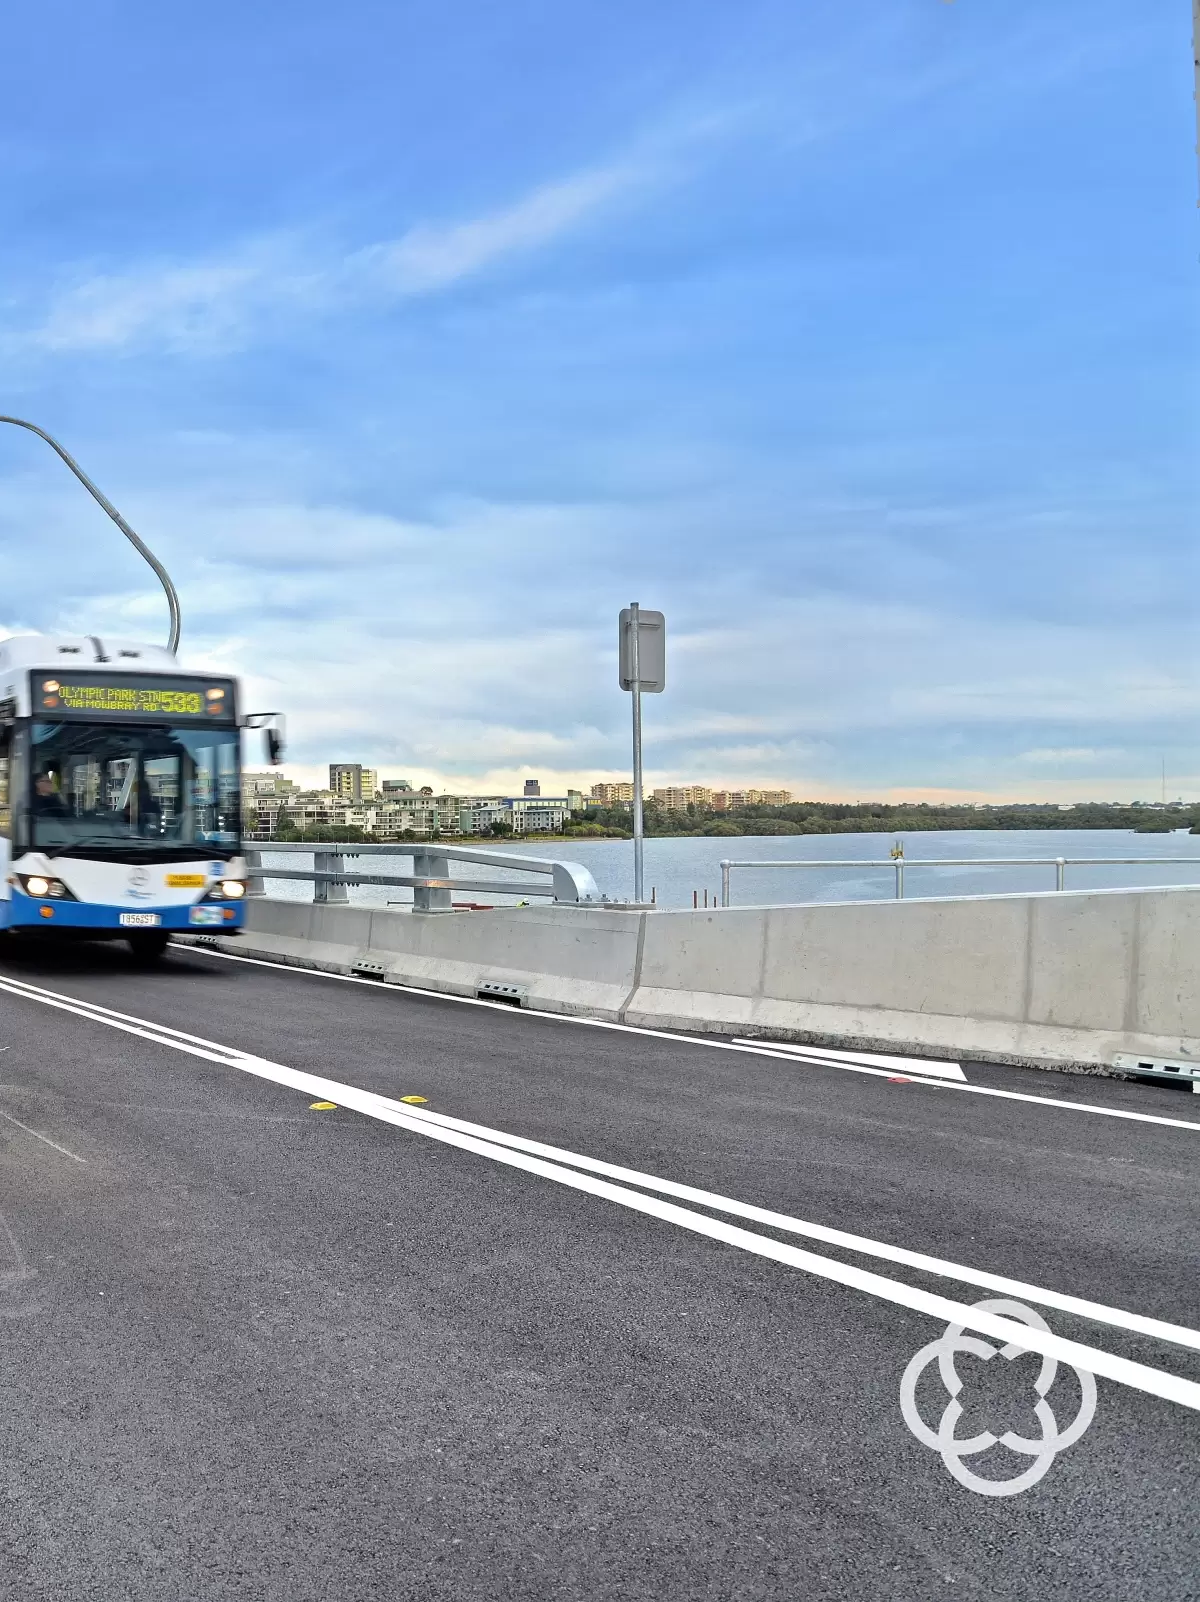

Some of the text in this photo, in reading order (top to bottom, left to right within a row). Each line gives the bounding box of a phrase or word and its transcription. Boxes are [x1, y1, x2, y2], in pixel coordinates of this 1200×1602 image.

[58, 686, 105, 699] OLYMPIC
[107, 688, 136, 702] PARK
[161, 691, 200, 713] 533
[64, 698, 158, 712] VIA MOWBRAY RD
